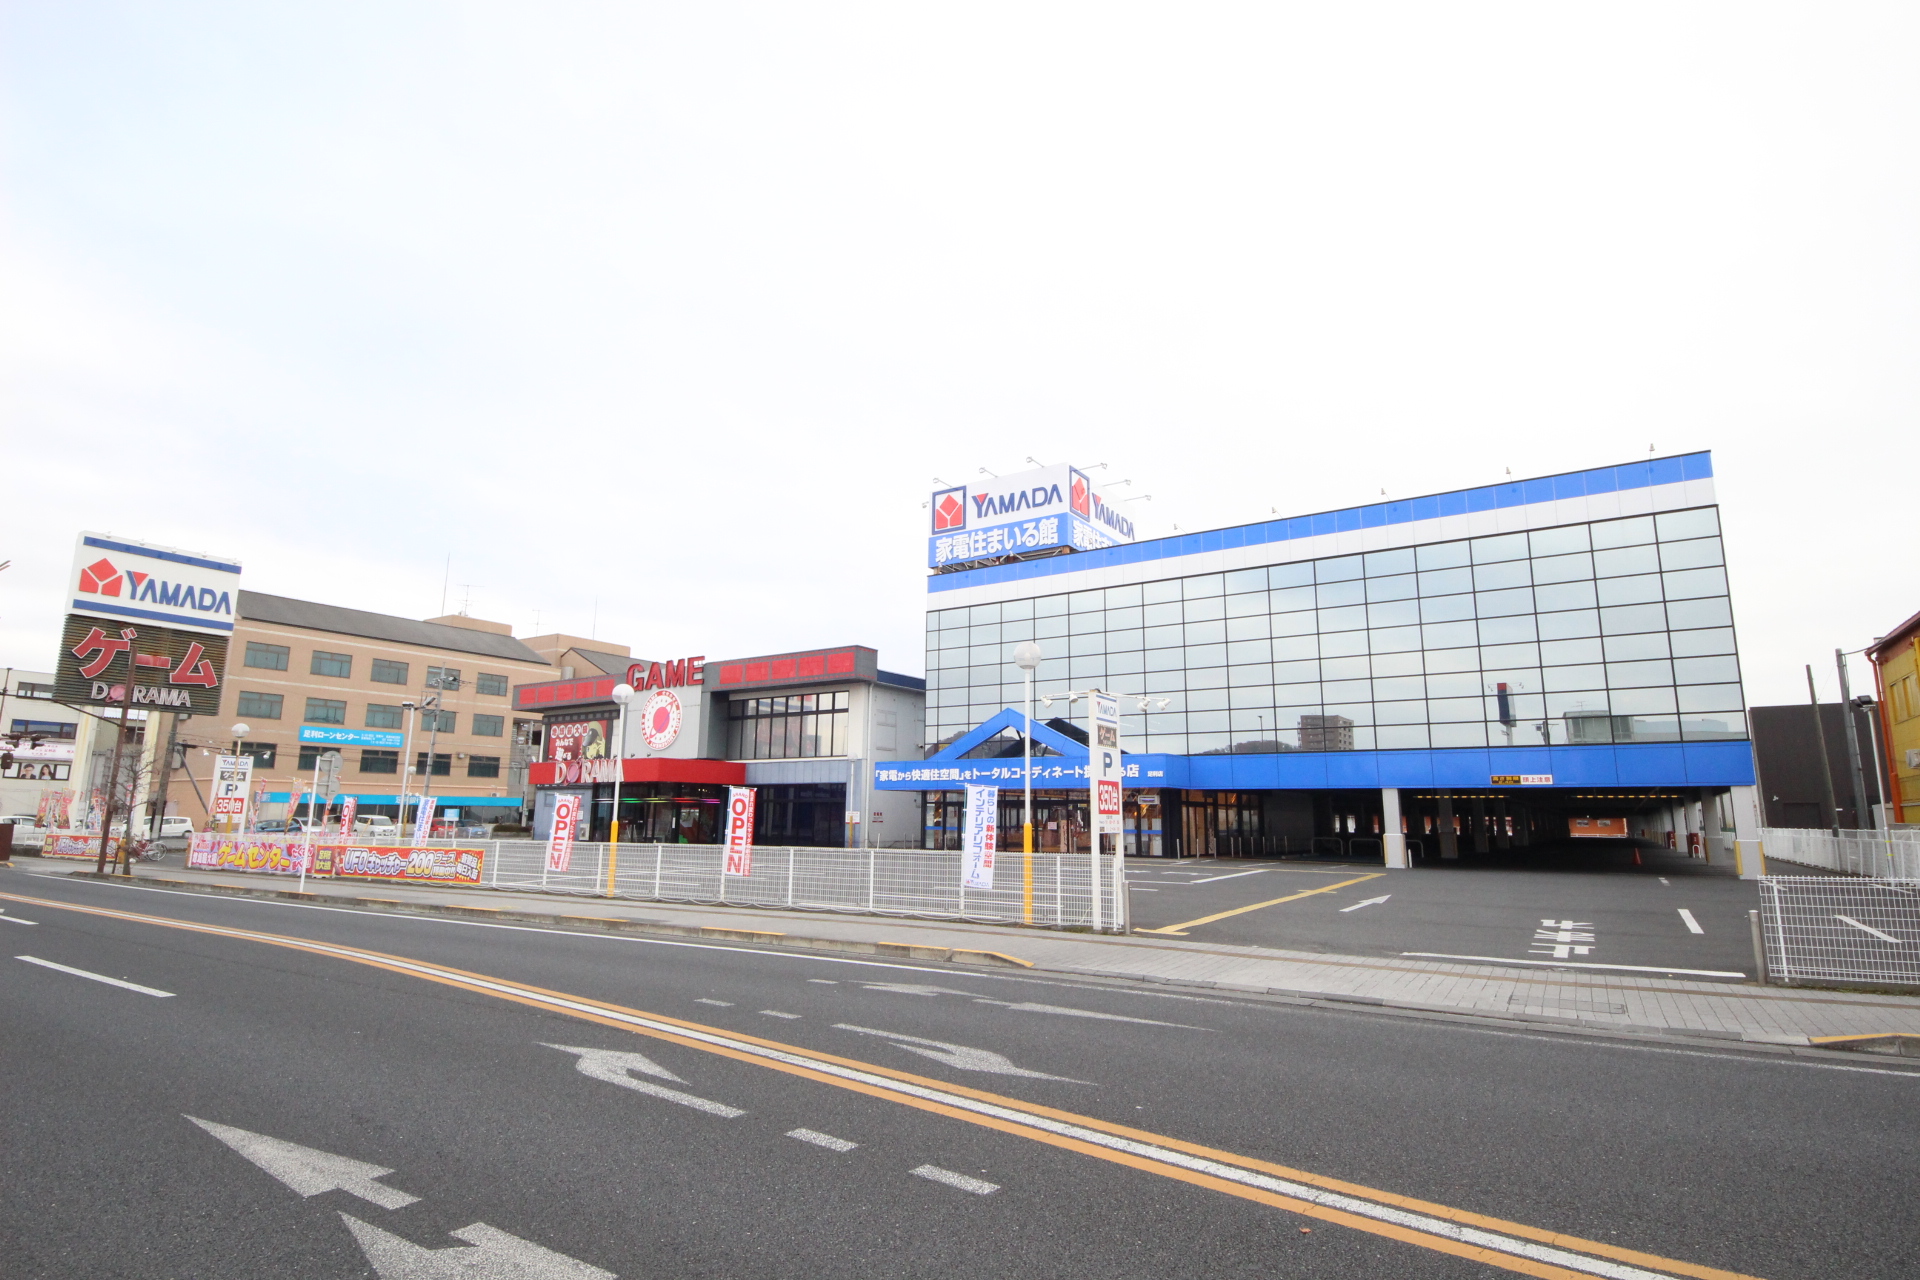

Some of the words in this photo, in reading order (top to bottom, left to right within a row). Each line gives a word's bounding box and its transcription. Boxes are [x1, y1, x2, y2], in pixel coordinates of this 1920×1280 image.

[972, 484, 1063, 518] YAMADA
[1092, 492, 1135, 541] YAMADA
[935, 517, 1059, 563] 家電住まいる館
[126, 570, 231, 615] YAMADA
[72, 627, 218, 688] ゲーム
[626, 655, 705, 691] GAME
[1096, 701, 1117, 717] YAMADA
[303, 730, 360, 741] 足利ローンセンター
[1103, 752, 1113, 777] P
[225, 784, 238, 796] P
[1099, 784, 1119, 811] 350台
[550, 803, 571, 869] OPEN
[727, 798, 747, 873] OPEN
[971, 789, 985, 879] インテリアリフォーム
[218, 842, 290, 869] ゲームセンター
[435, 851, 456, 864] ブース
[1528, 919, 1595, 958] 止まれ
